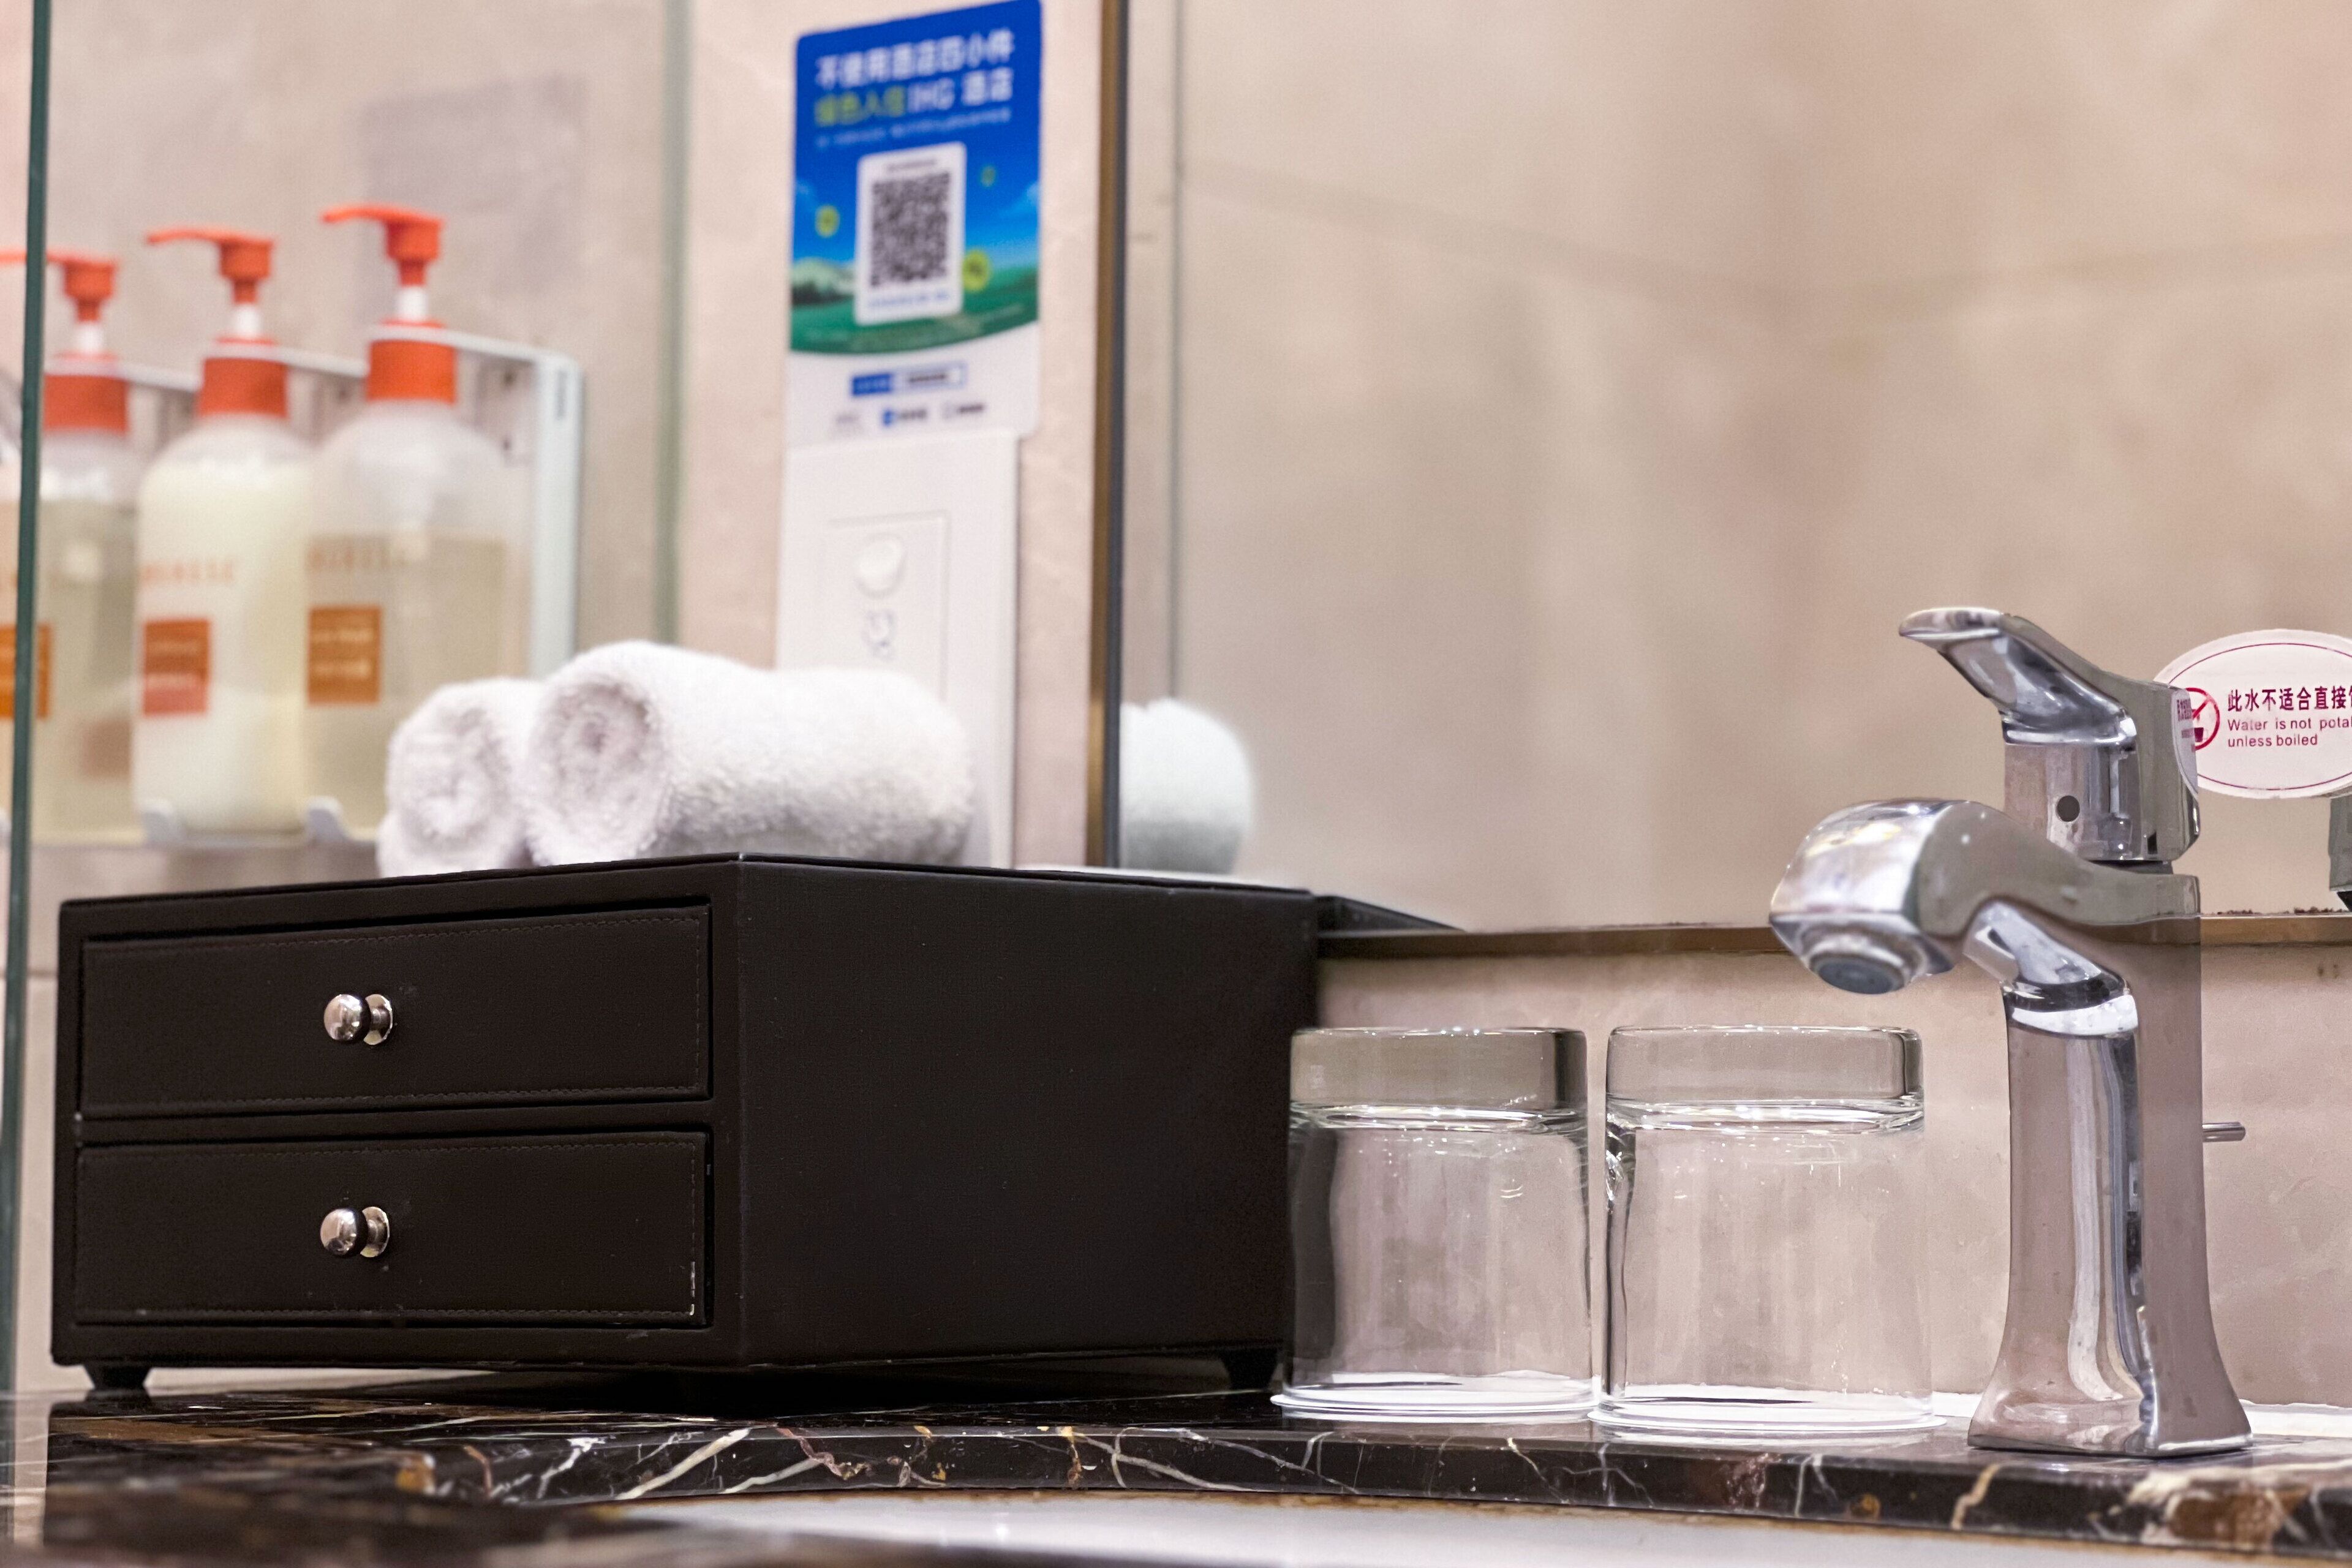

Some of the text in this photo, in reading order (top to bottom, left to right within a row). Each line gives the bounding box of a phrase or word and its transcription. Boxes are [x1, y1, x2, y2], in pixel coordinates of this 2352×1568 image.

[2228, 685, 2352, 712] 此水不适合直接
[2228, 716, 2352, 731] Water is not pota
[2228, 734, 2317, 747] unless boiled
